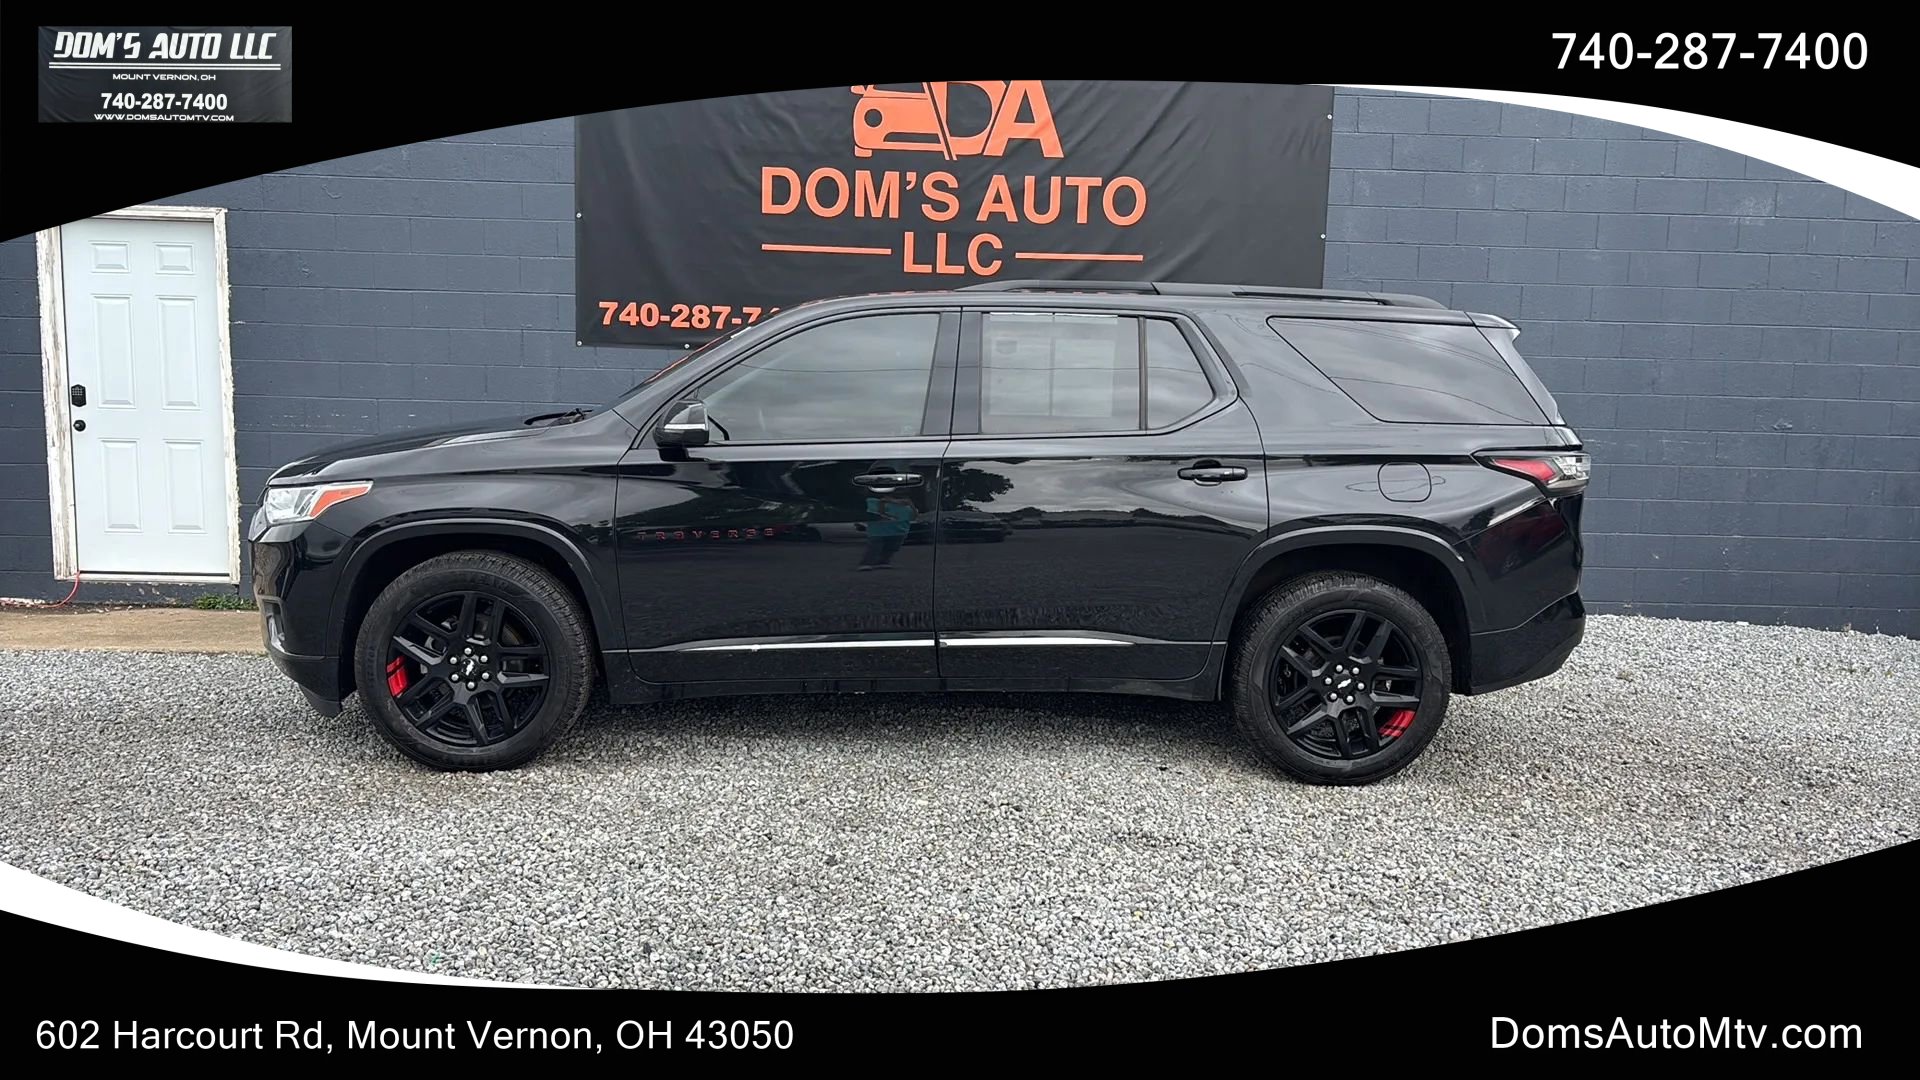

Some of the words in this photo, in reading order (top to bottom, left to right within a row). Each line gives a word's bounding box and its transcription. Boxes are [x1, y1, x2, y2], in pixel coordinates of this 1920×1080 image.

[761, 165, 960, 222] DOM'S
[977, 174, 1147, 227] AUTO
[903, 231, 1003, 277] LLC
[599, 301, 780, 330] 740-287-7
